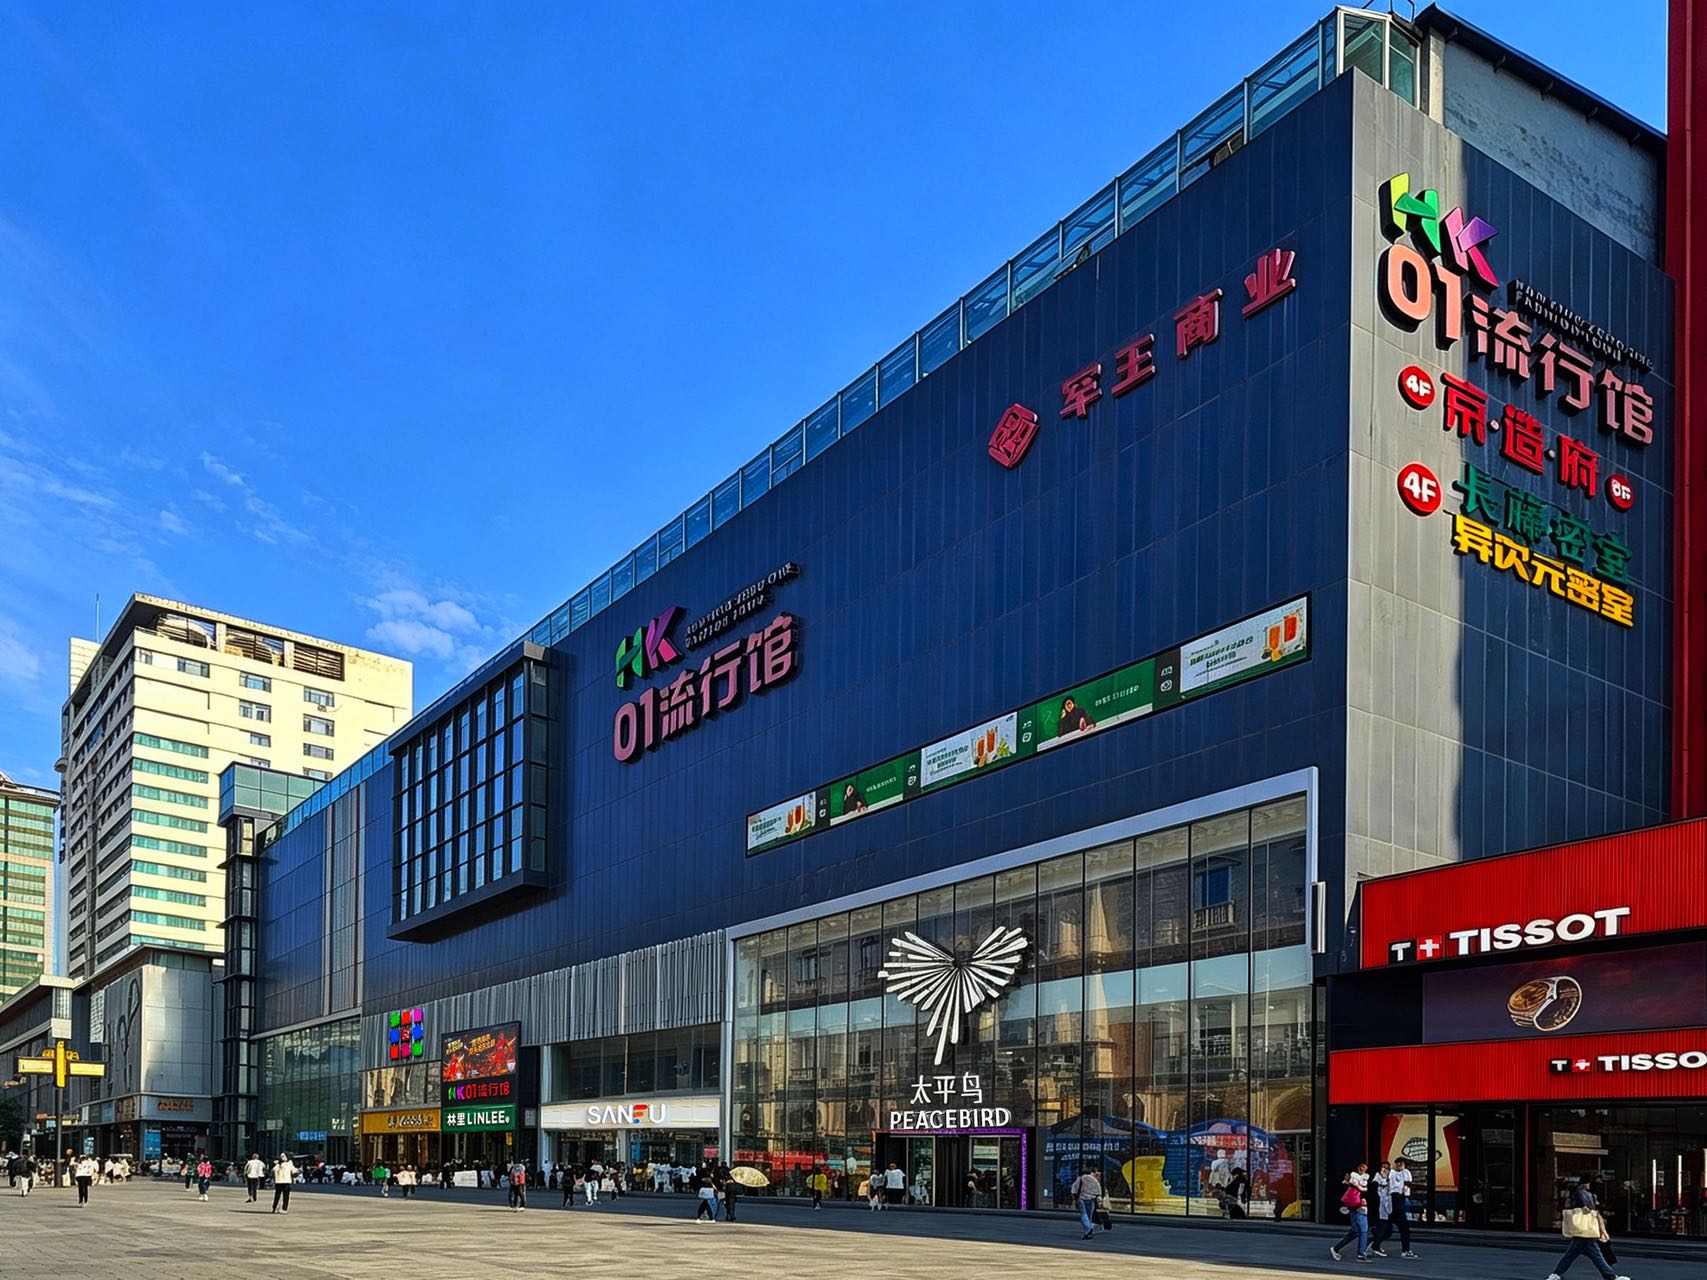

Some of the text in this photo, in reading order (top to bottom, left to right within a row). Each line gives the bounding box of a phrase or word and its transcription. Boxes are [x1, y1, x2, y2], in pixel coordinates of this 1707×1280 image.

[1382, 172, 1499, 288] HK
[1382, 244, 1653, 445] 01流行馆
[1405, 374, 1431, 397] 4F
[1403, 471, 1438, 503] 4F
[616, 606, 679, 688] HK
[614, 614, 794, 762] 01流行馆
[1450, 907, 1631, 956] TISSOT
[1598, 1051, 1707, 1072] TISSO
[910, 1072, 983, 1105] 太平鸟
[447, 1112, 466, 1127] 林里
[467, 1110, 506, 1125] LINLEE
[586, 1103, 666, 1126] SANFU
[889, 1107, 1012, 1130] PEACEBIRD
